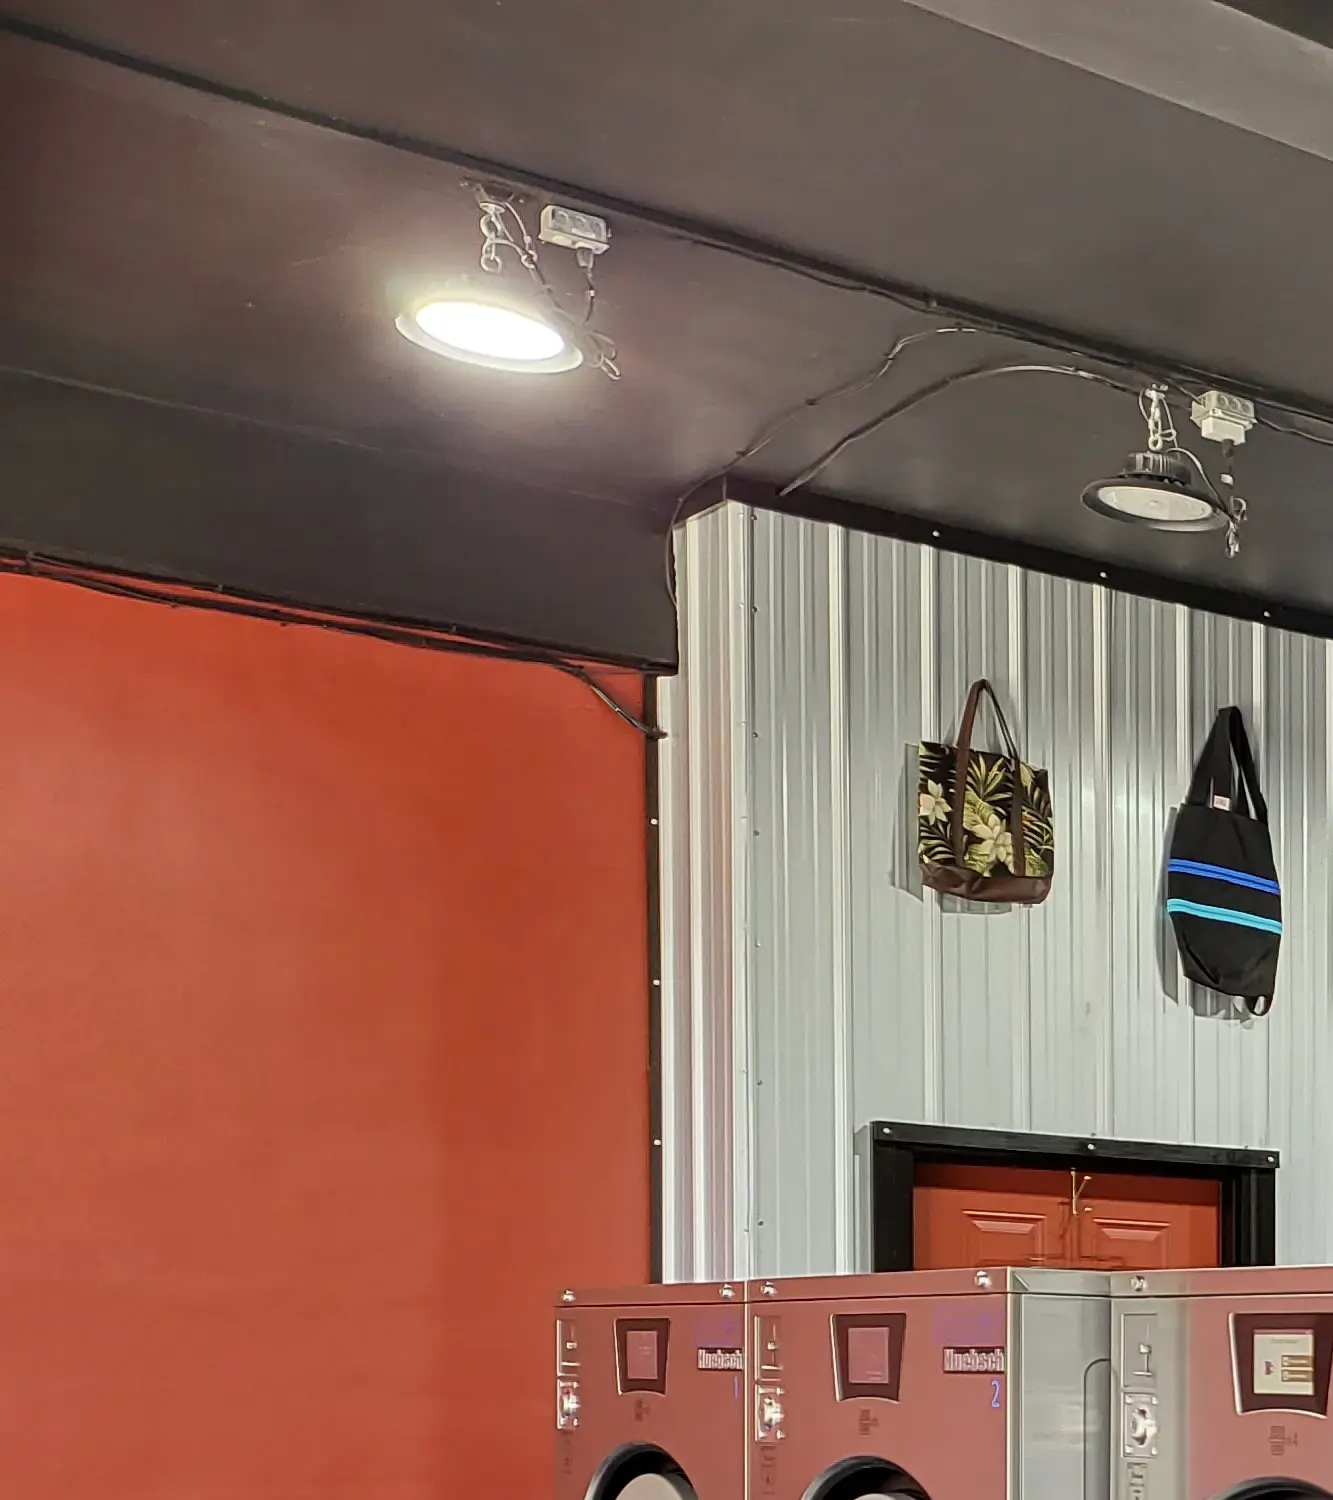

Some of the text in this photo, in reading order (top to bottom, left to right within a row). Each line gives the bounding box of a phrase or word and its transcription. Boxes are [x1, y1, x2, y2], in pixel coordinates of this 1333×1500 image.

[698, 1348, 744, 1370] Huebsch
[943, 1348, 1005, 1372] Huebsch
[991, 1379, 1001, 1408] 2
